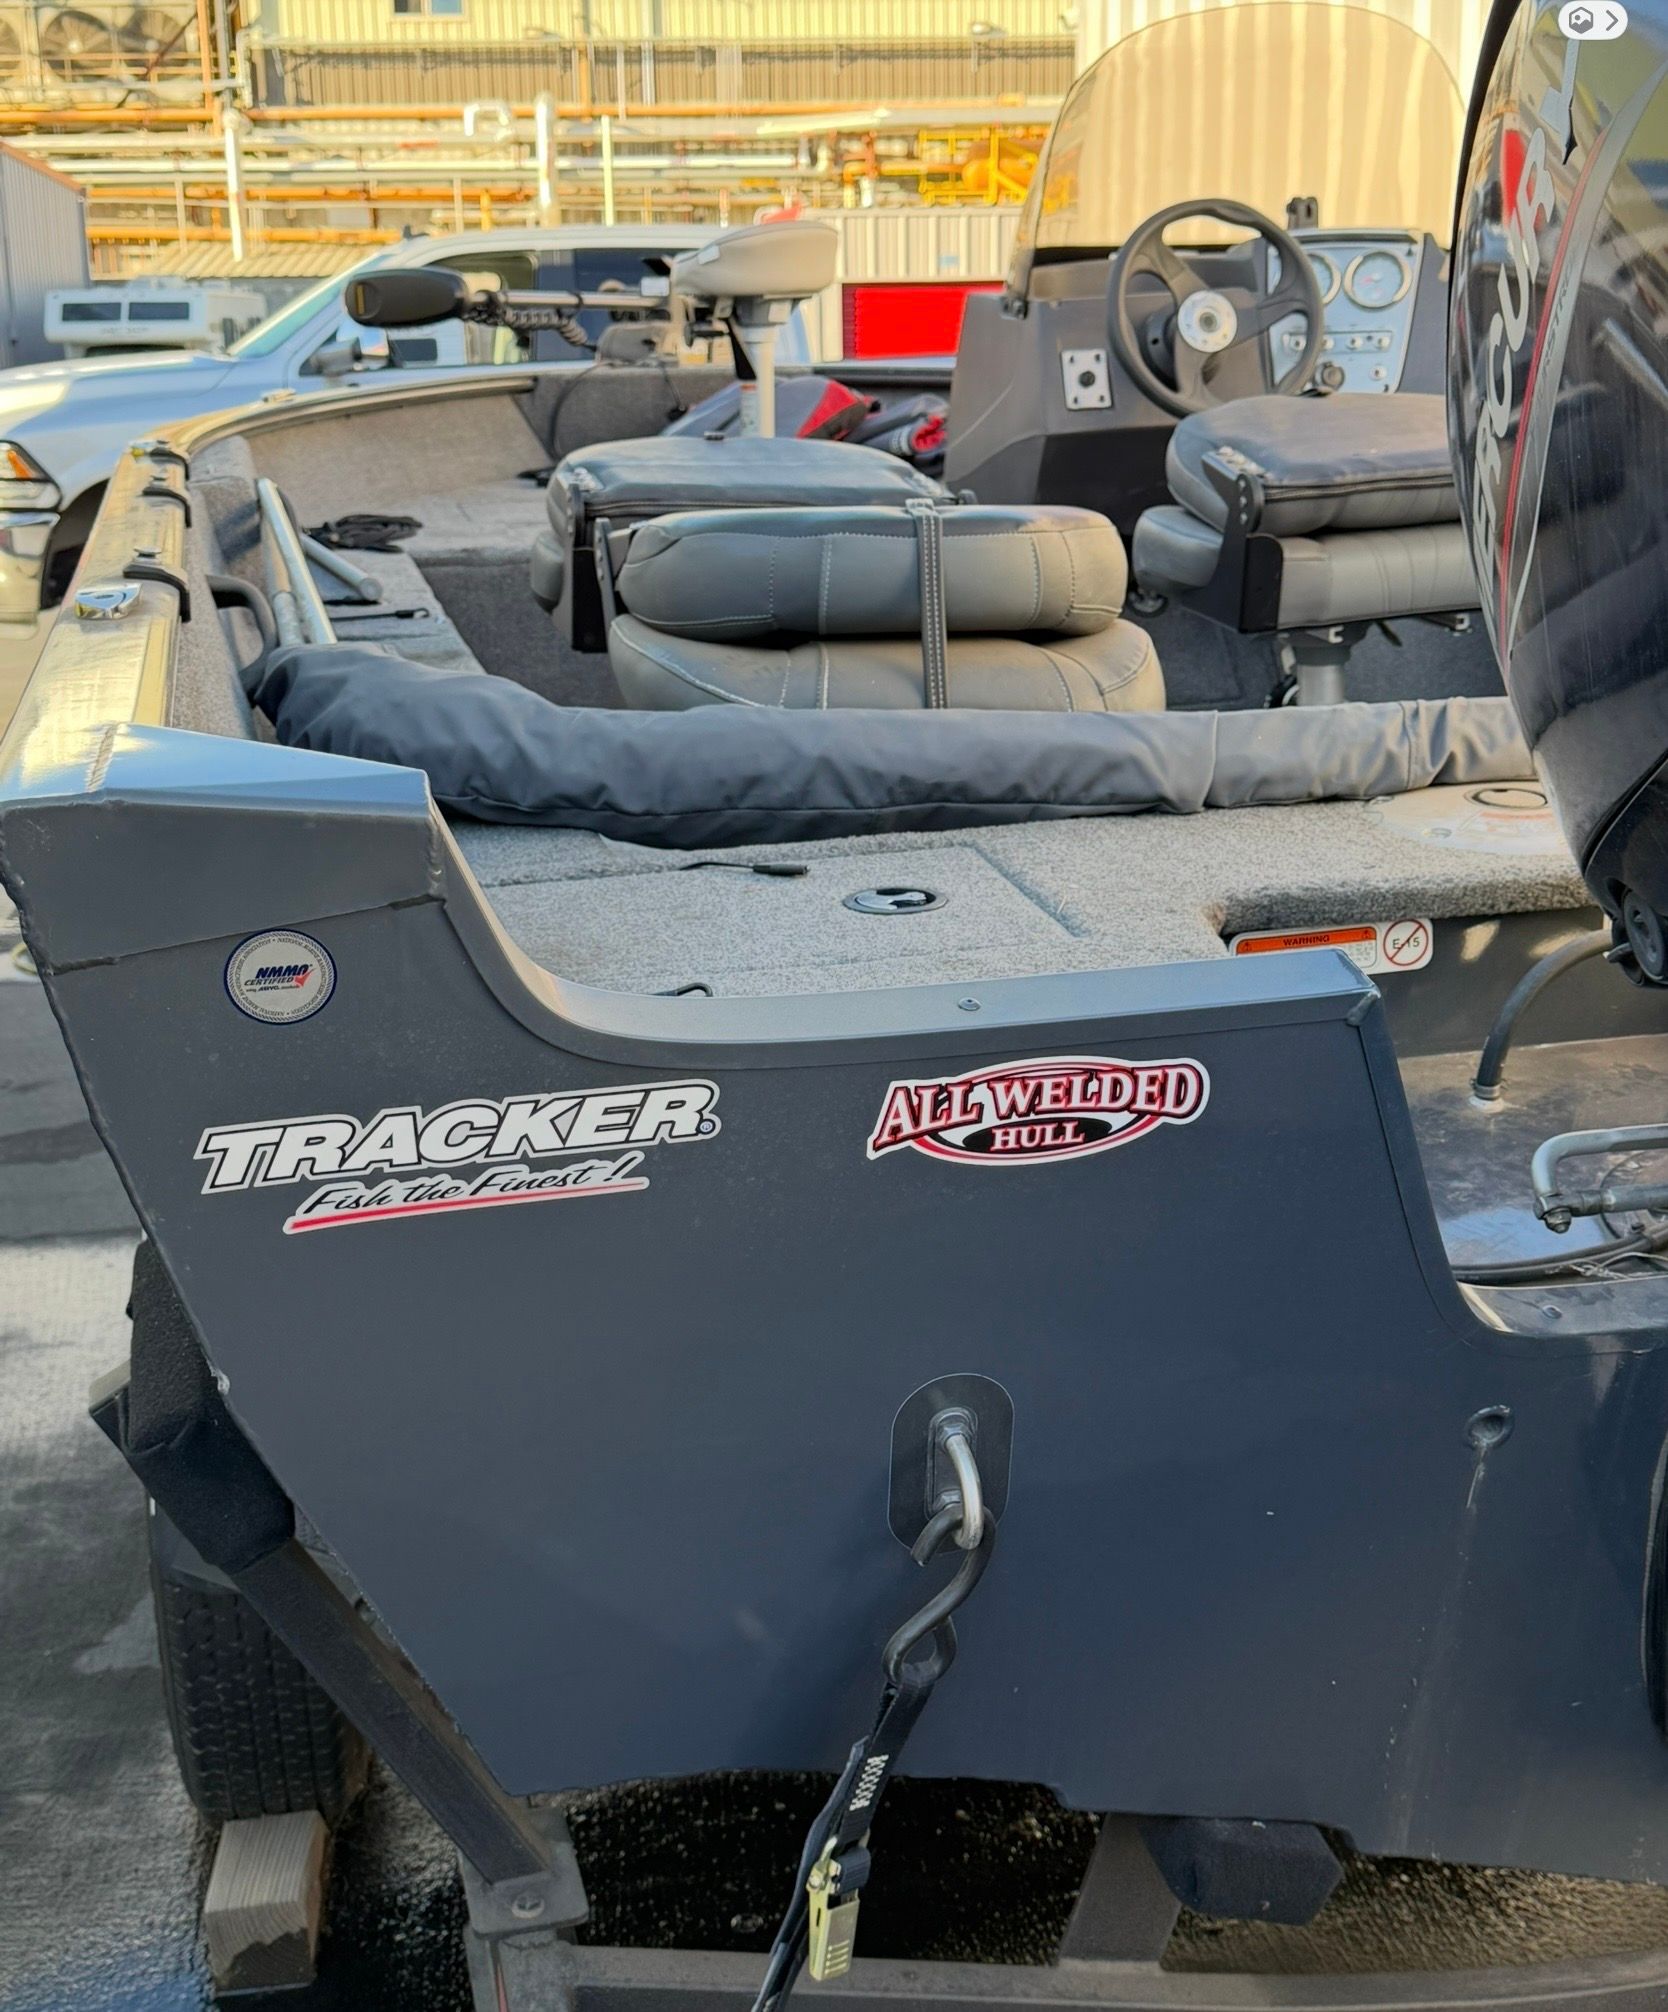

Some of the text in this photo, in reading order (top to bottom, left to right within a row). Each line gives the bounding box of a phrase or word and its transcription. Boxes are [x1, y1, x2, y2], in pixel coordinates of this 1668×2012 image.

[1283, 934, 1330, 946] WARNING
[244, 976, 294, 986] CERTIFIED
[874, 1065, 1203, 1151] ALL WELDED
[990, 1121, 1085, 1152] HULL
[303, 1186, 393, 1214] Fish
[402, 1181, 463, 1201] the
